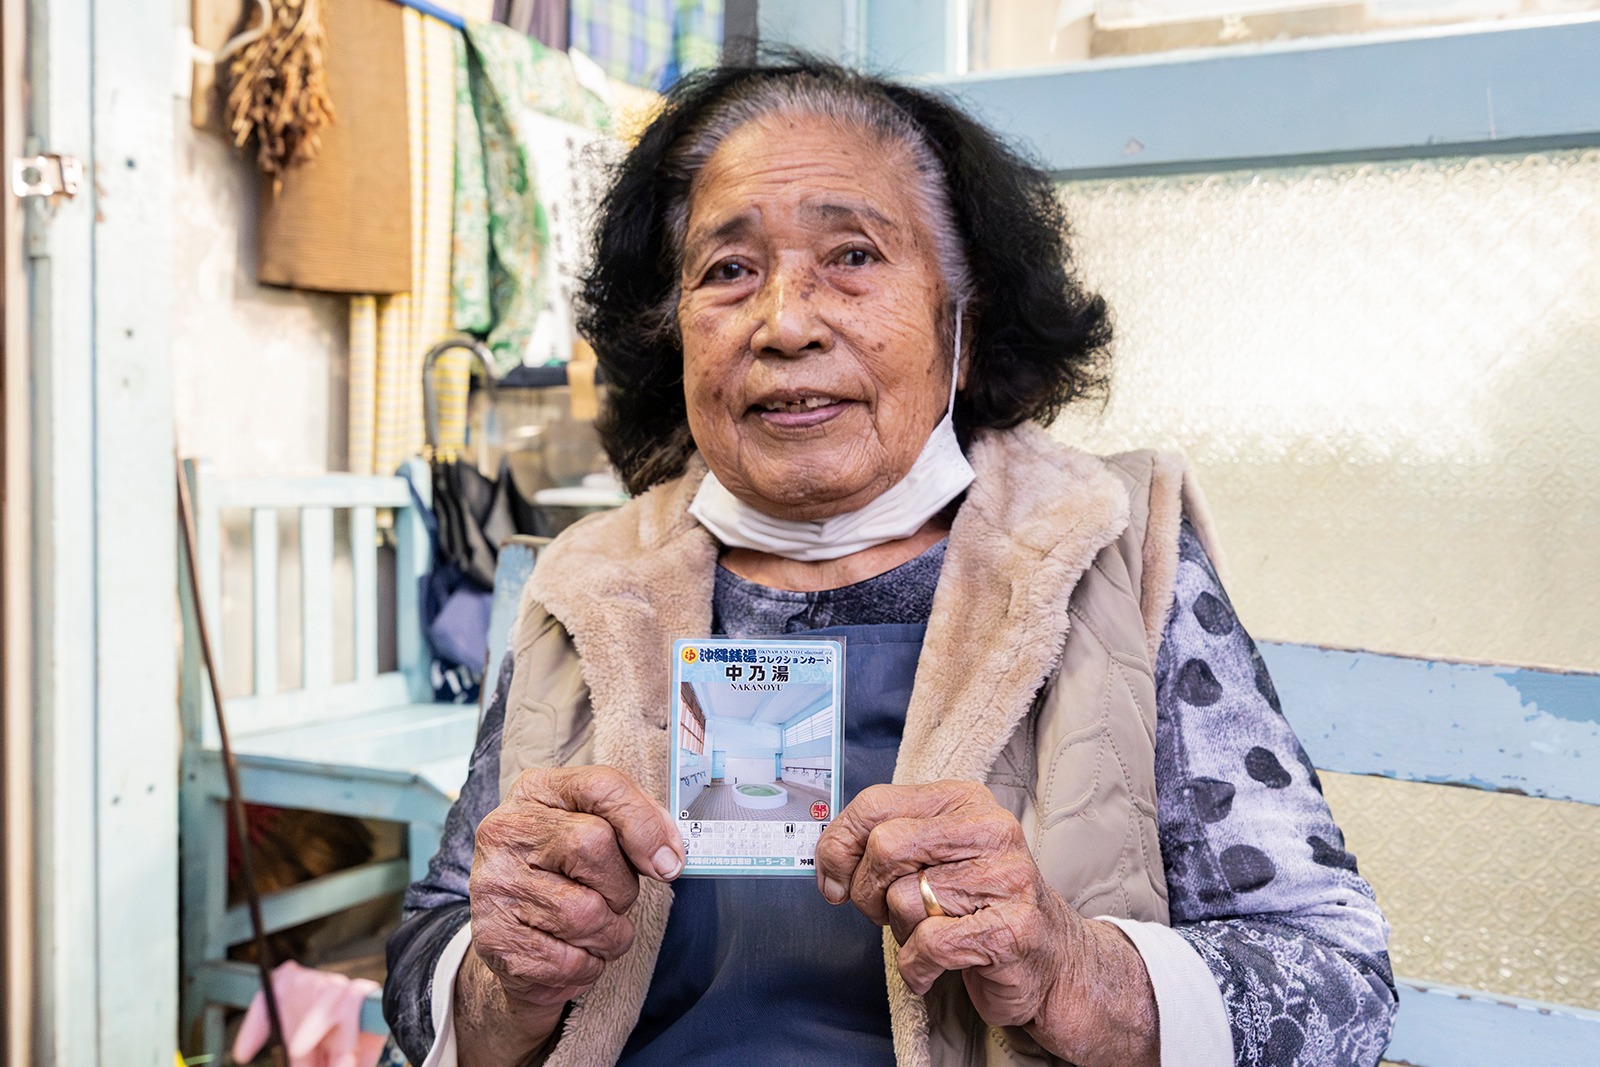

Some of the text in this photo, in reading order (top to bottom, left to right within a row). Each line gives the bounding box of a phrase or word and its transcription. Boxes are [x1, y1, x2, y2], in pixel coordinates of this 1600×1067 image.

[685, 648, 757, 663] ゆ 沖縄銭湯
[759, 656, 832, 664] コレクションカード
[726, 664, 789, 682] 中乃湯
[731, 683, 783, 691] NAKANOYU
